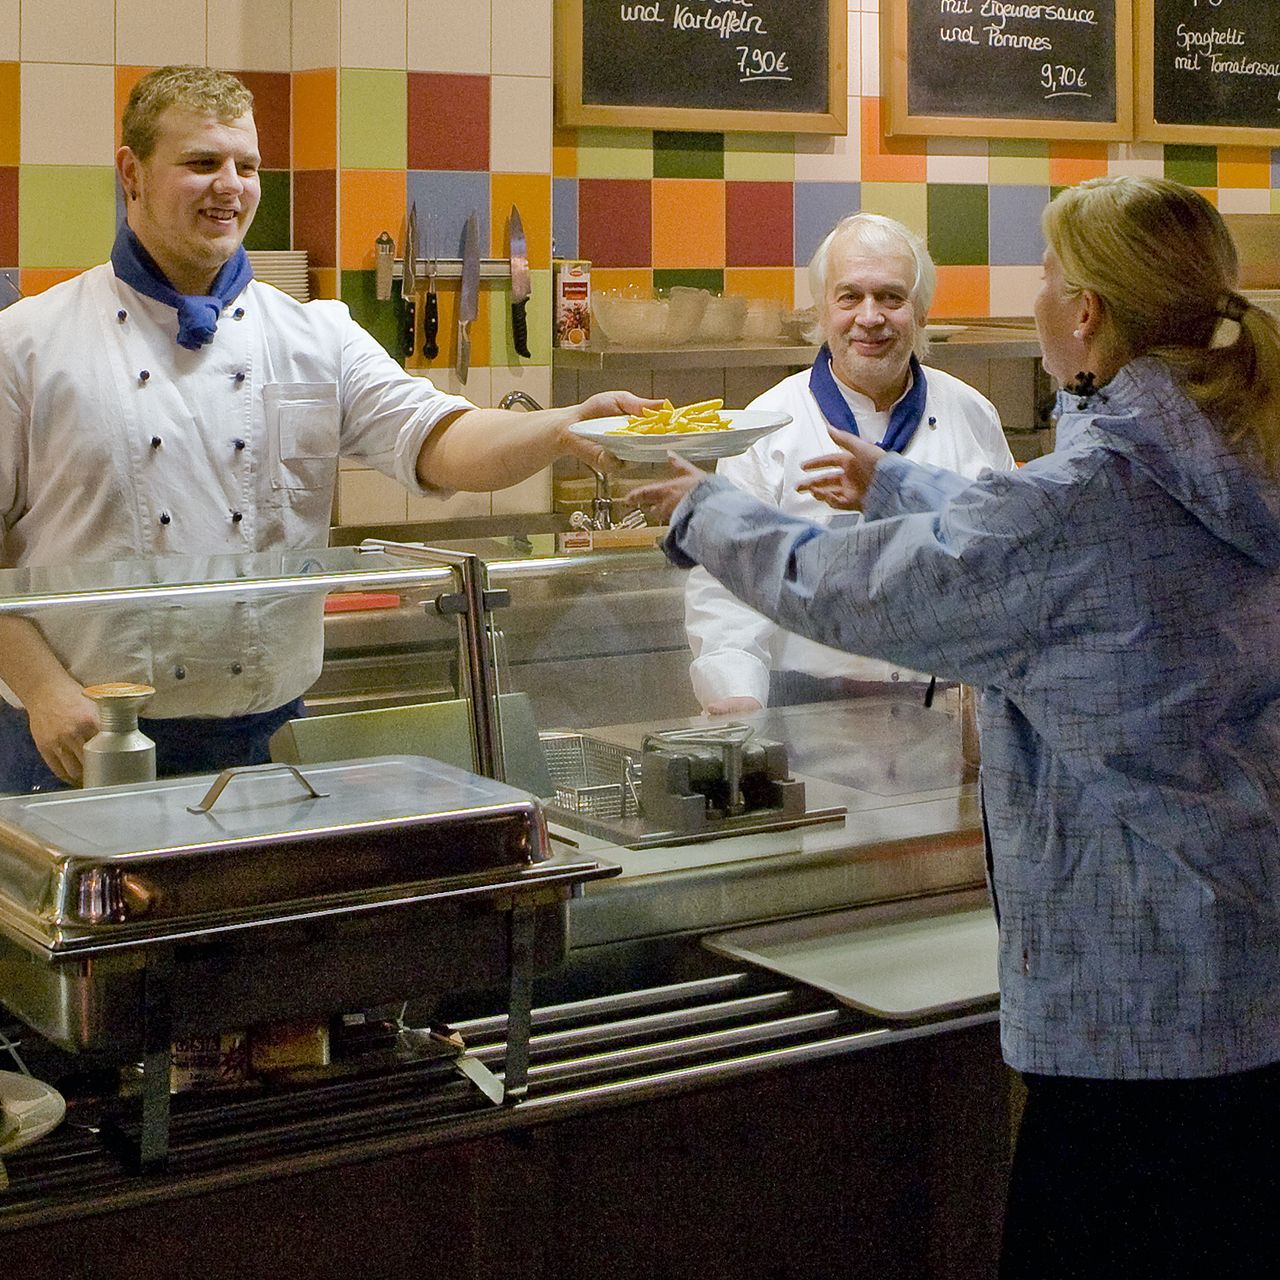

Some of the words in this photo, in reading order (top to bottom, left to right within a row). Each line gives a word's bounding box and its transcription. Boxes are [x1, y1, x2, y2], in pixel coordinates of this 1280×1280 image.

[620, 2, 665, 22] und
[673, 4, 767, 39] Kartoffeln
[940, 26, 979, 45] und
[983, 26, 1052, 51] Pommes
[1176, 23, 1245, 56] Spaghetti
[736, 46, 789, 76] 7,90€
[1175, 53, 1201, 71] mit
[1041, 63, 1087, 91] 9,70€
